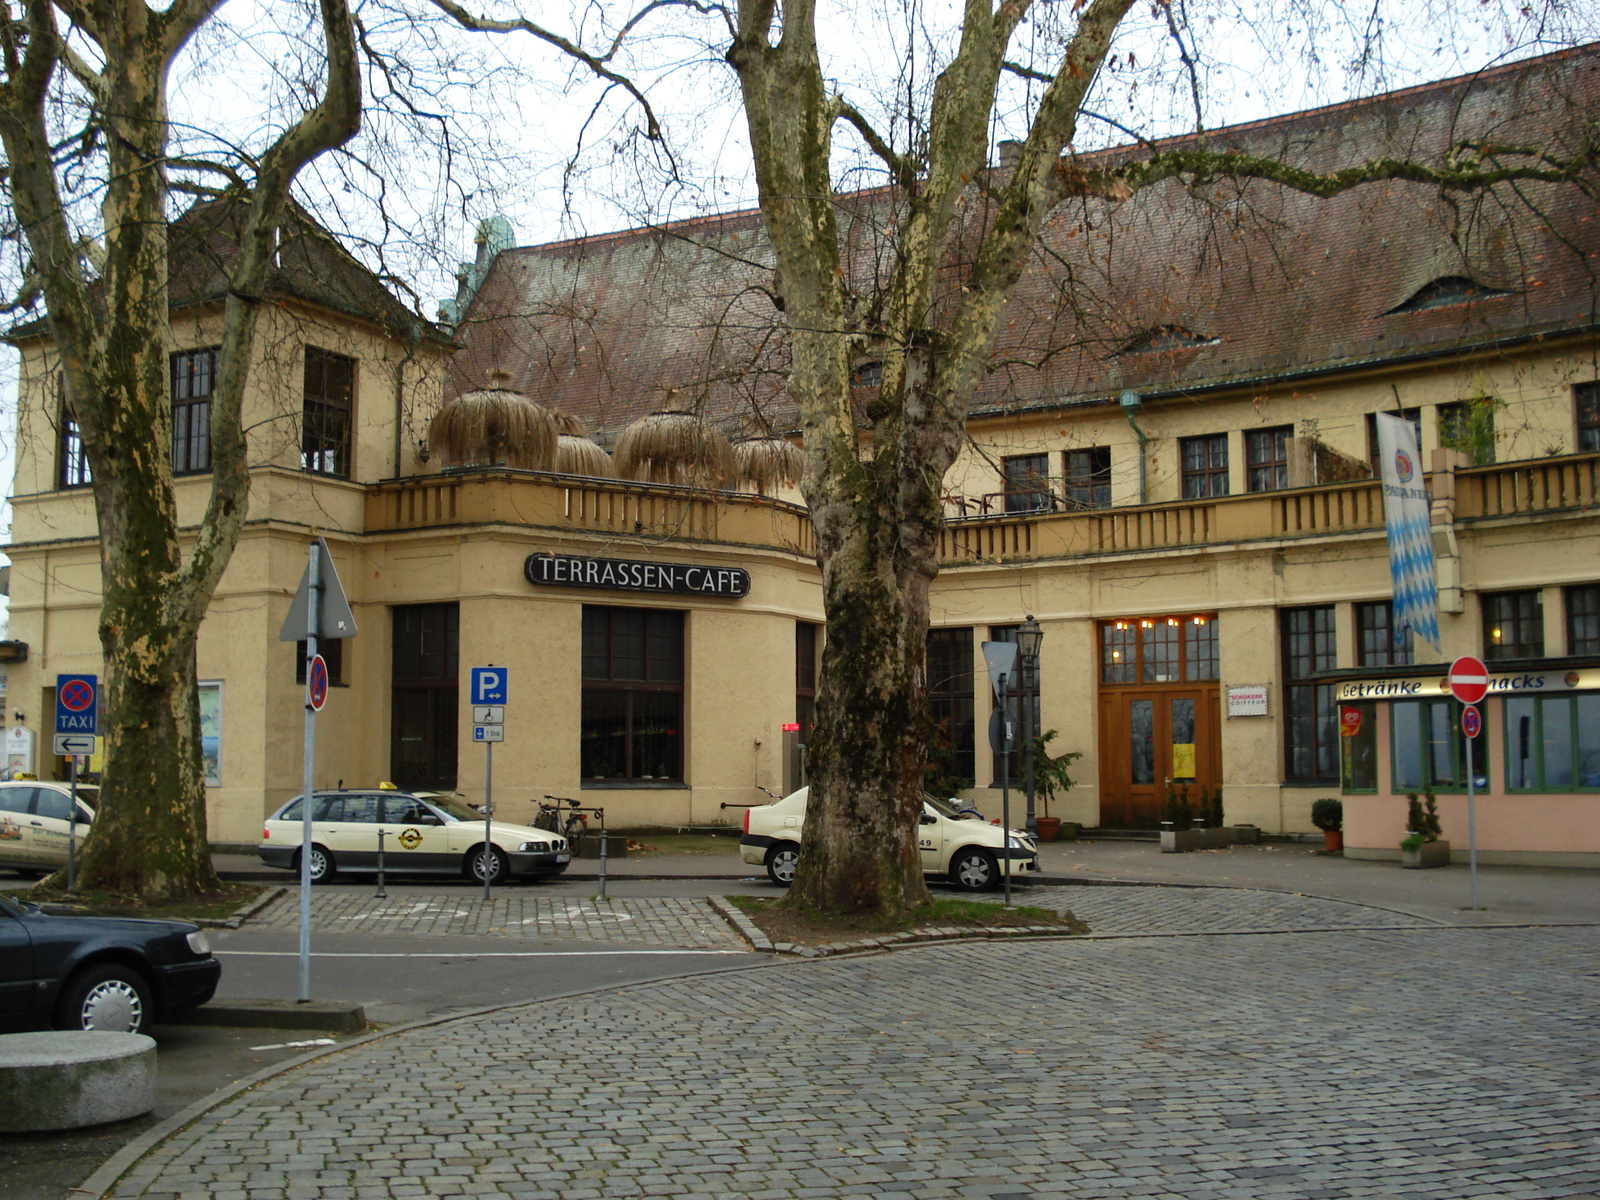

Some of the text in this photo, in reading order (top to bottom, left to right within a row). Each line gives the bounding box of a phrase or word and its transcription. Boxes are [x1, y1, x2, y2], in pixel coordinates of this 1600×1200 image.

[1384, 484, 1432, 500] PAUANER
[538, 556, 741, 594] TERRASSEN-CAFE
[479, 671, 499, 700] P
[1342, 674, 1546, 698] Getränke nacks
[60, 715, 94, 729] TAXI
